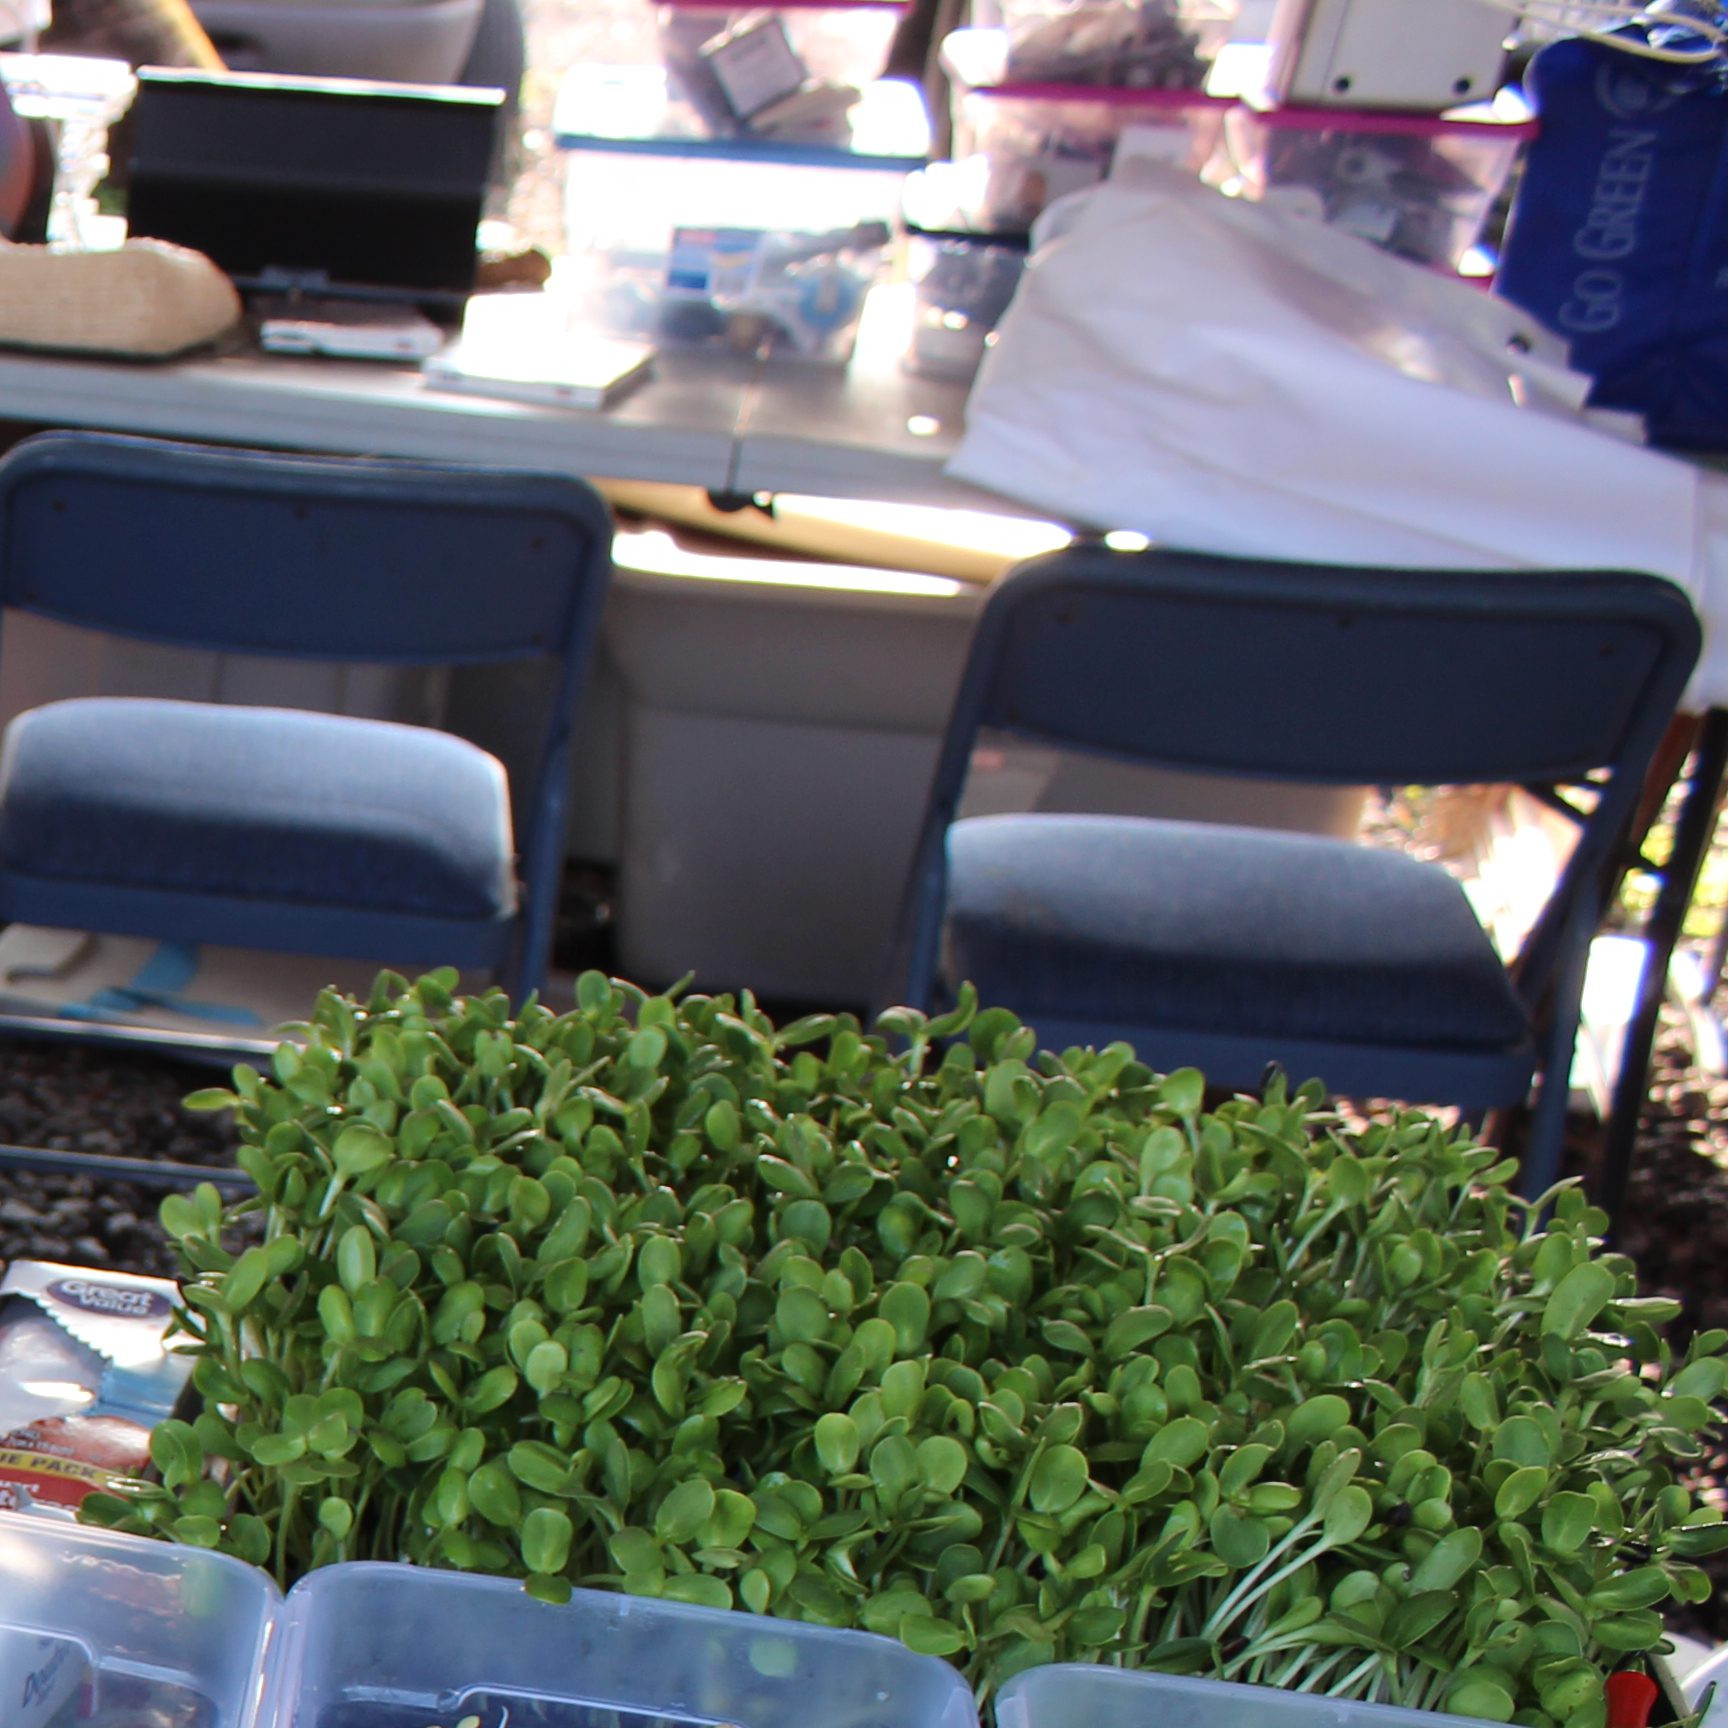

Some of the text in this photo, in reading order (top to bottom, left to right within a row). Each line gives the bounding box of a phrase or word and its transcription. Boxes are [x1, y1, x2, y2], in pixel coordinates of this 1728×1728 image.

[1559, 129, 1661, 333] GO GREEN
[60, 1278, 155, 1316] Great Value
[30, 1456, 95, 1478] PACK
